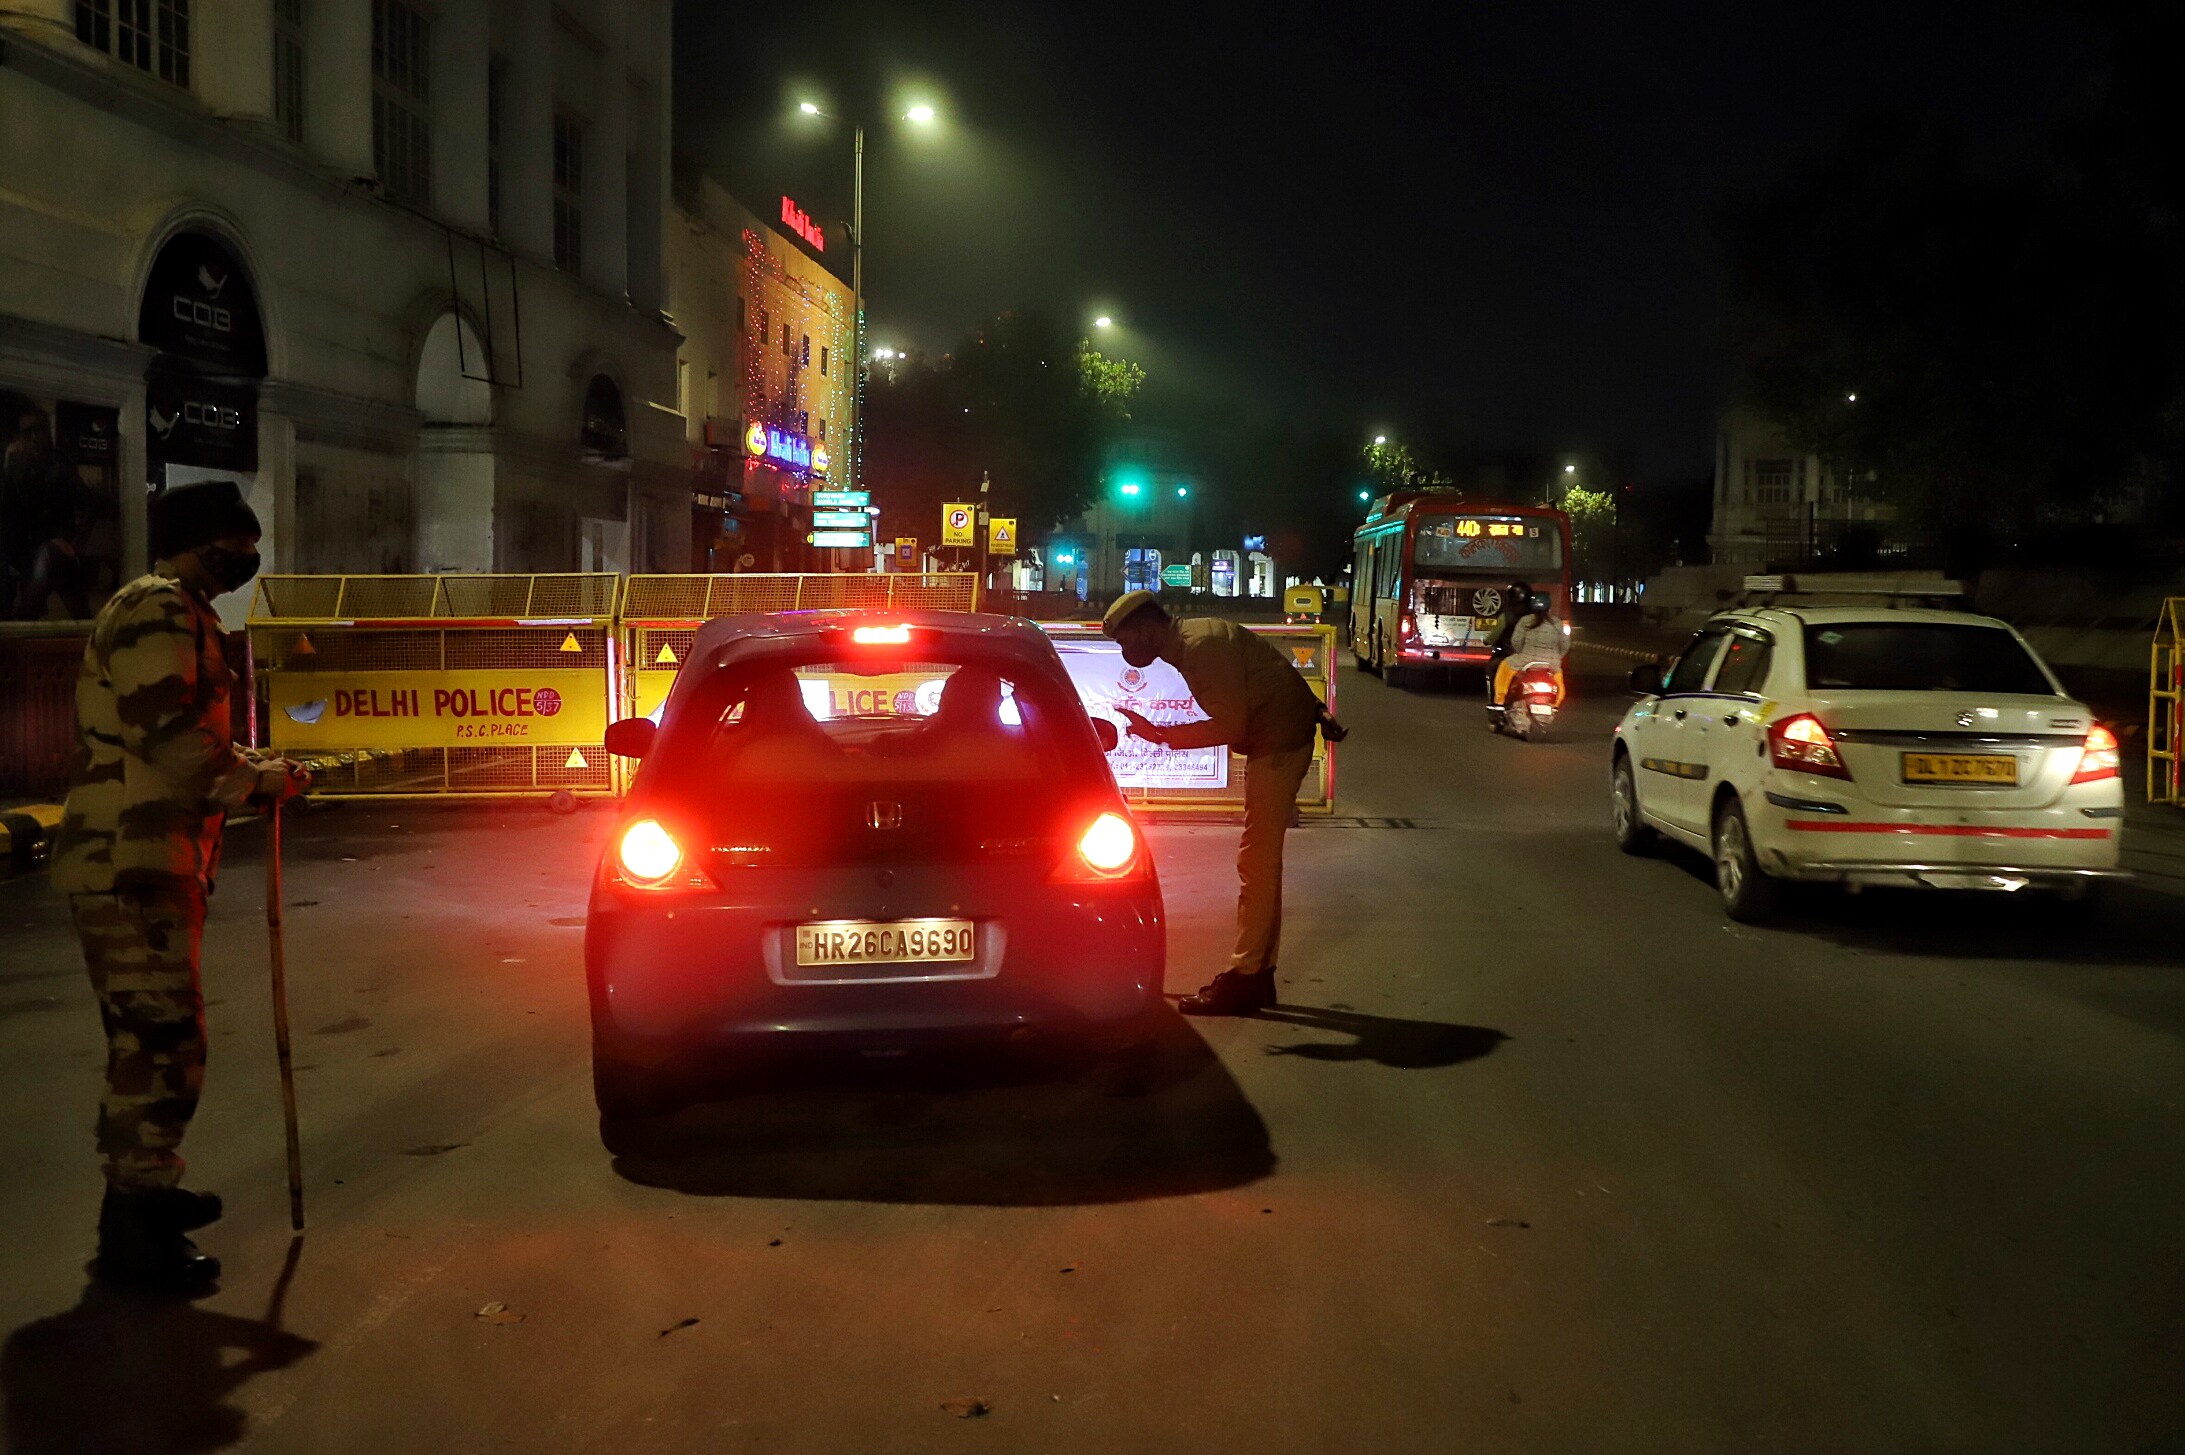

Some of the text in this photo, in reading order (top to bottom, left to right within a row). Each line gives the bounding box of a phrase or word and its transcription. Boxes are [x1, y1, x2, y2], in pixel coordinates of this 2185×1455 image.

[173, 295, 231, 332] COB
[184, 401, 237, 430] COB
[335, 687, 534, 717] DELHI POLICE
[813, 928, 974, 960] HR26CA9690
